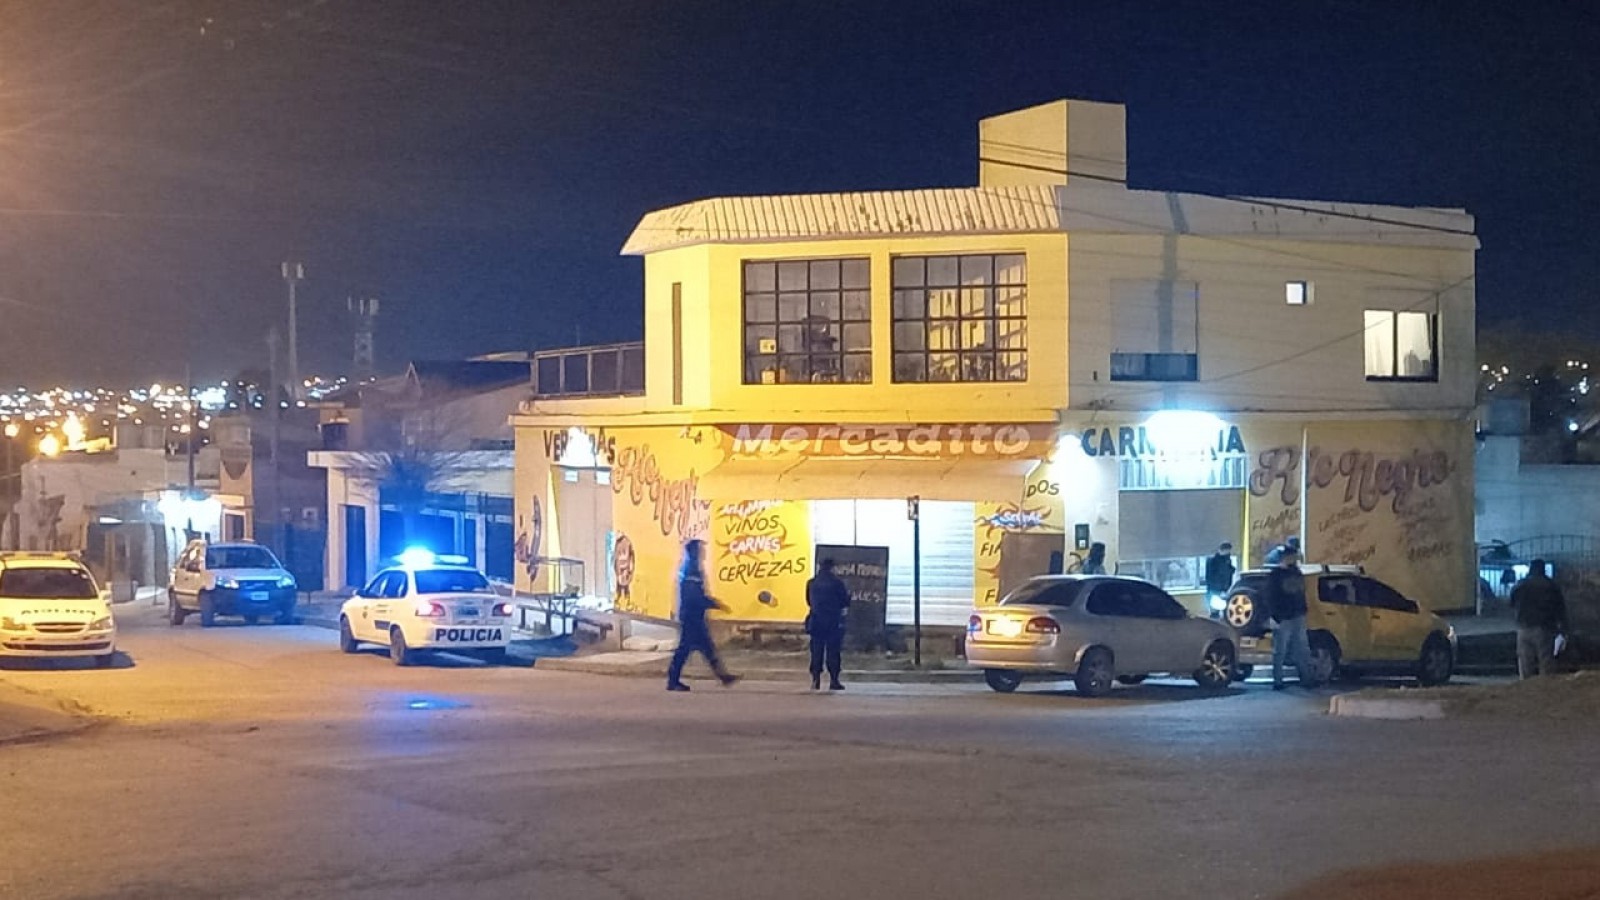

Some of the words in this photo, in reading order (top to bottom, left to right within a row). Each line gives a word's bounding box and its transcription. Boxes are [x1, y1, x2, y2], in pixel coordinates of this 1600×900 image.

[543, 426, 616, 465] VERAS
[731, 423, 1030, 456] Mercadito
[1081, 424, 1246, 461] CARNIA
[725, 514, 780, 536] VINOS
[729, 535, 781, 555] CARNES
[718, 557, 807, 585] CERVEZAS
[435, 628, 502, 642] POLICIA
